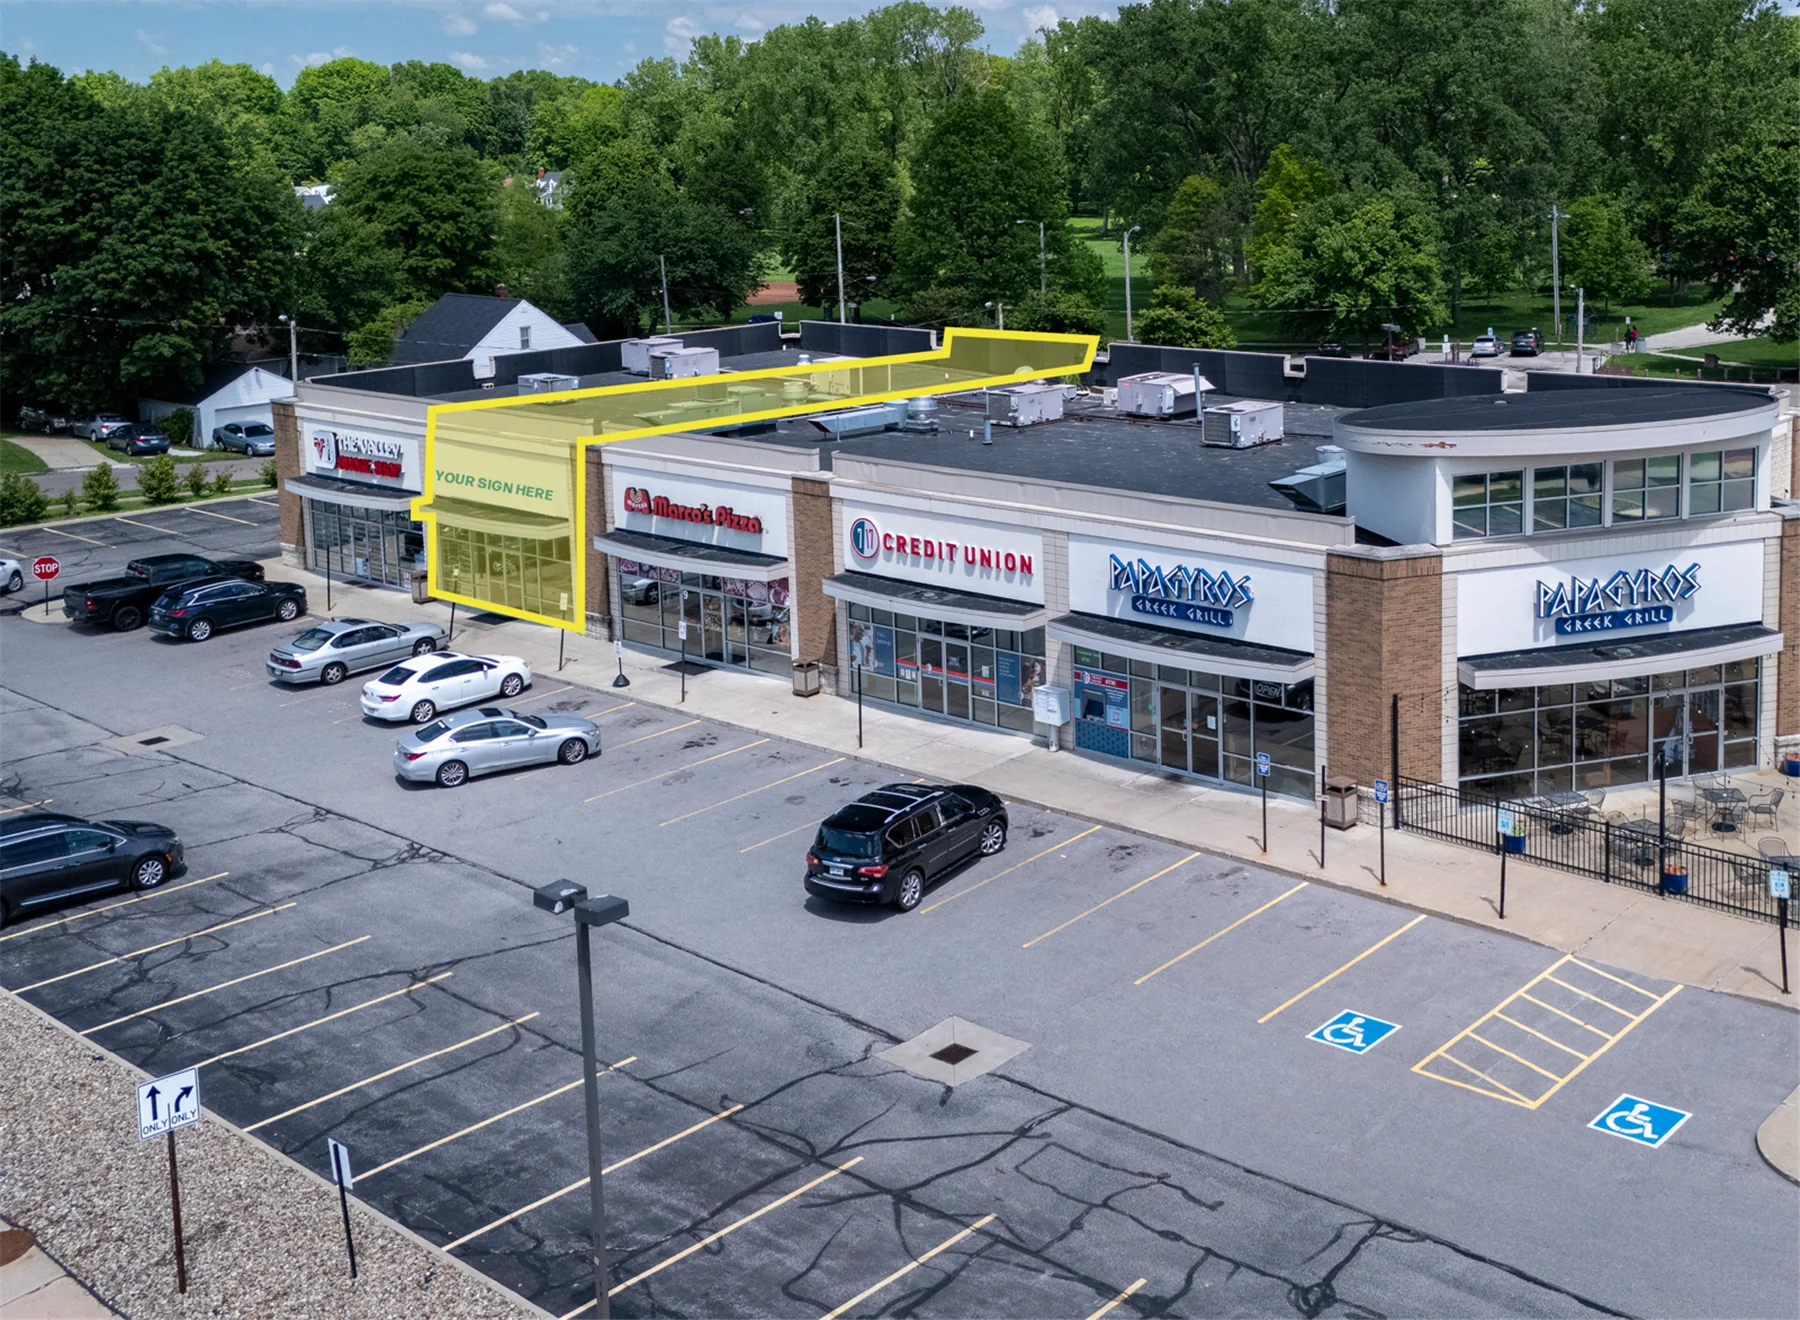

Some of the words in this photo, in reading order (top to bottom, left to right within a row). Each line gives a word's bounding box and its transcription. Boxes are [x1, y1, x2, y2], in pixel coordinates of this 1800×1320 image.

[337, 435, 359, 452] THE
[360, 438, 402, 459] VALLEY
[653, 495, 713, 525] Marco's
[715, 505, 762, 534] Pizza
[883, 532, 957, 562] CREDIT
[964, 545, 1033, 575] UNION
[34, 562, 59, 574] STOP
[1135, 599, 1178, 617] GREEK
[1186, 607, 1226, 625] GRILL
[1563, 614, 1613, 633] GREEK
[1624, 608, 1668, 626] GRILL
[1256, 682, 1281, 699] OPEN
[142, 1118, 168, 1135] ONLY
[171, 1109, 197, 1125] ONLY
